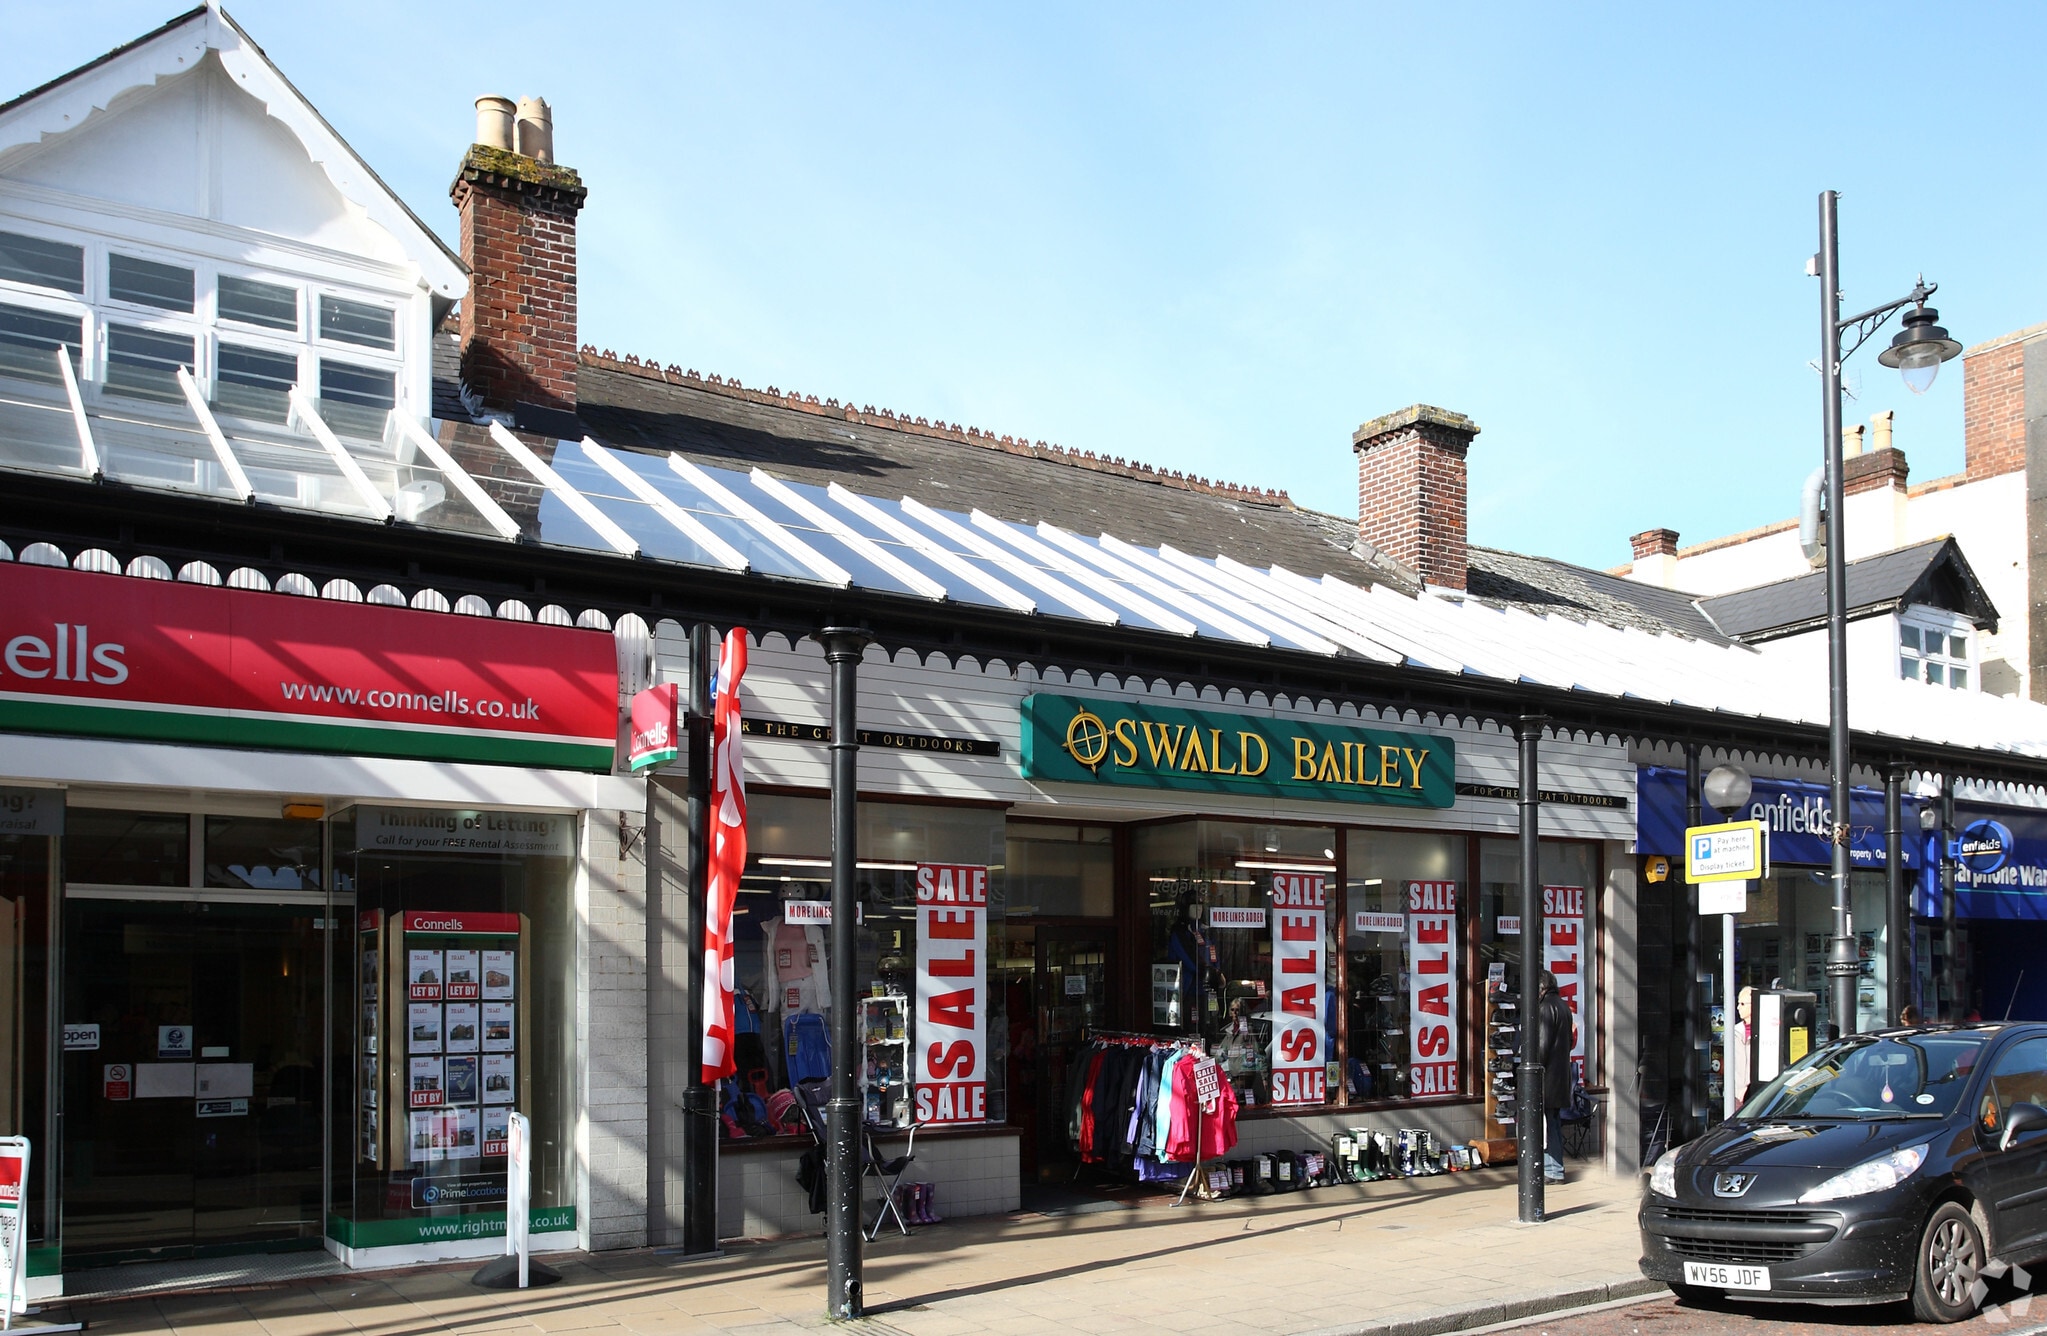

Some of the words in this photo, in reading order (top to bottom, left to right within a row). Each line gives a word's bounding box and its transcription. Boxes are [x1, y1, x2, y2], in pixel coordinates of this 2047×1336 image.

[0, 623, 128, 685] ells
[281, 681, 539, 721] www.connells.co.uk
[766, 722, 798, 736] THE
[884, 734, 973, 752] OUTDOORS
[1063, 706, 1270, 776] OSWALD
[1292, 736, 1429, 789] BAILEY
[1473, 786, 1493, 795] FOR
[1501, 788, 1519, 798] THE
[1563, 794, 1613, 806] OUTDOORS
[378, 810, 457, 832] Thinking
[463, 813, 482, 830] of
[487, 815, 558, 837] Letting?
[1751, 793, 1832, 835] enfields
[375, 834, 395, 845] Call
[398, 835, 414, 846] for
[415, 838, 440, 848] your
[442, 837, 466, 848] FREE
[469, 838, 502, 849] Rental
[502, 840, 560, 851] Assessment
[1722, 844, 1750, 853] machine
[1962, 838, 2001, 852] enfields
[1699, 862, 1724, 871] Display
[1725, 860, 1745, 869] ticket
[1850, 850, 1872, 861] roperty
[917, 867, 986, 902] SALE
[1273, 876, 1325, 906] SALE
[1409, 882, 1455, 911] SALE
[1543, 888, 1583, 915] SALE
[789, 905, 811, 918] MORE
[1212, 911, 1229, 922] MORE
[1229, 911, 1245, 922] LINES
[1246, 912, 1264, 923] ADDED
[1358, 915, 1373, 926] MORE
[1373, 916, 1386, 927] LINES
[1387, 916, 1403, 928] ADDED
[413, 917, 463, 930] Connells
[412, 986, 427, 997] LET
[428, 986, 440, 997] BY
[450, 986, 464, 996] LET
[465, 985, 476, 996] BY
[927, 909, 976, 1080] SALE
[1280, 915, 1317, 1062] SALE
[1417, 919, 1449, 1057] SALE
[64, 1029, 97, 1043] open
[1196, 1066, 1215, 1079] SALE
[1198, 1074, 1215, 1086] SALE
[1411, 1065, 1457, 1094] SALE
[1199, 1082, 1218, 1095] SALE
[1272, 1071, 1324, 1102] SALE
[413, 1094, 428, 1104] LET
[429, 1092, 441, 1103] BY
[916, 1086, 985, 1121] SALE
[486, 1143, 499, 1153] LET
[501, 1143, 508, 1153] B
[1690, 1265, 1728, 1284] WV56
[1733, 1268, 1762, 1286] JDF
